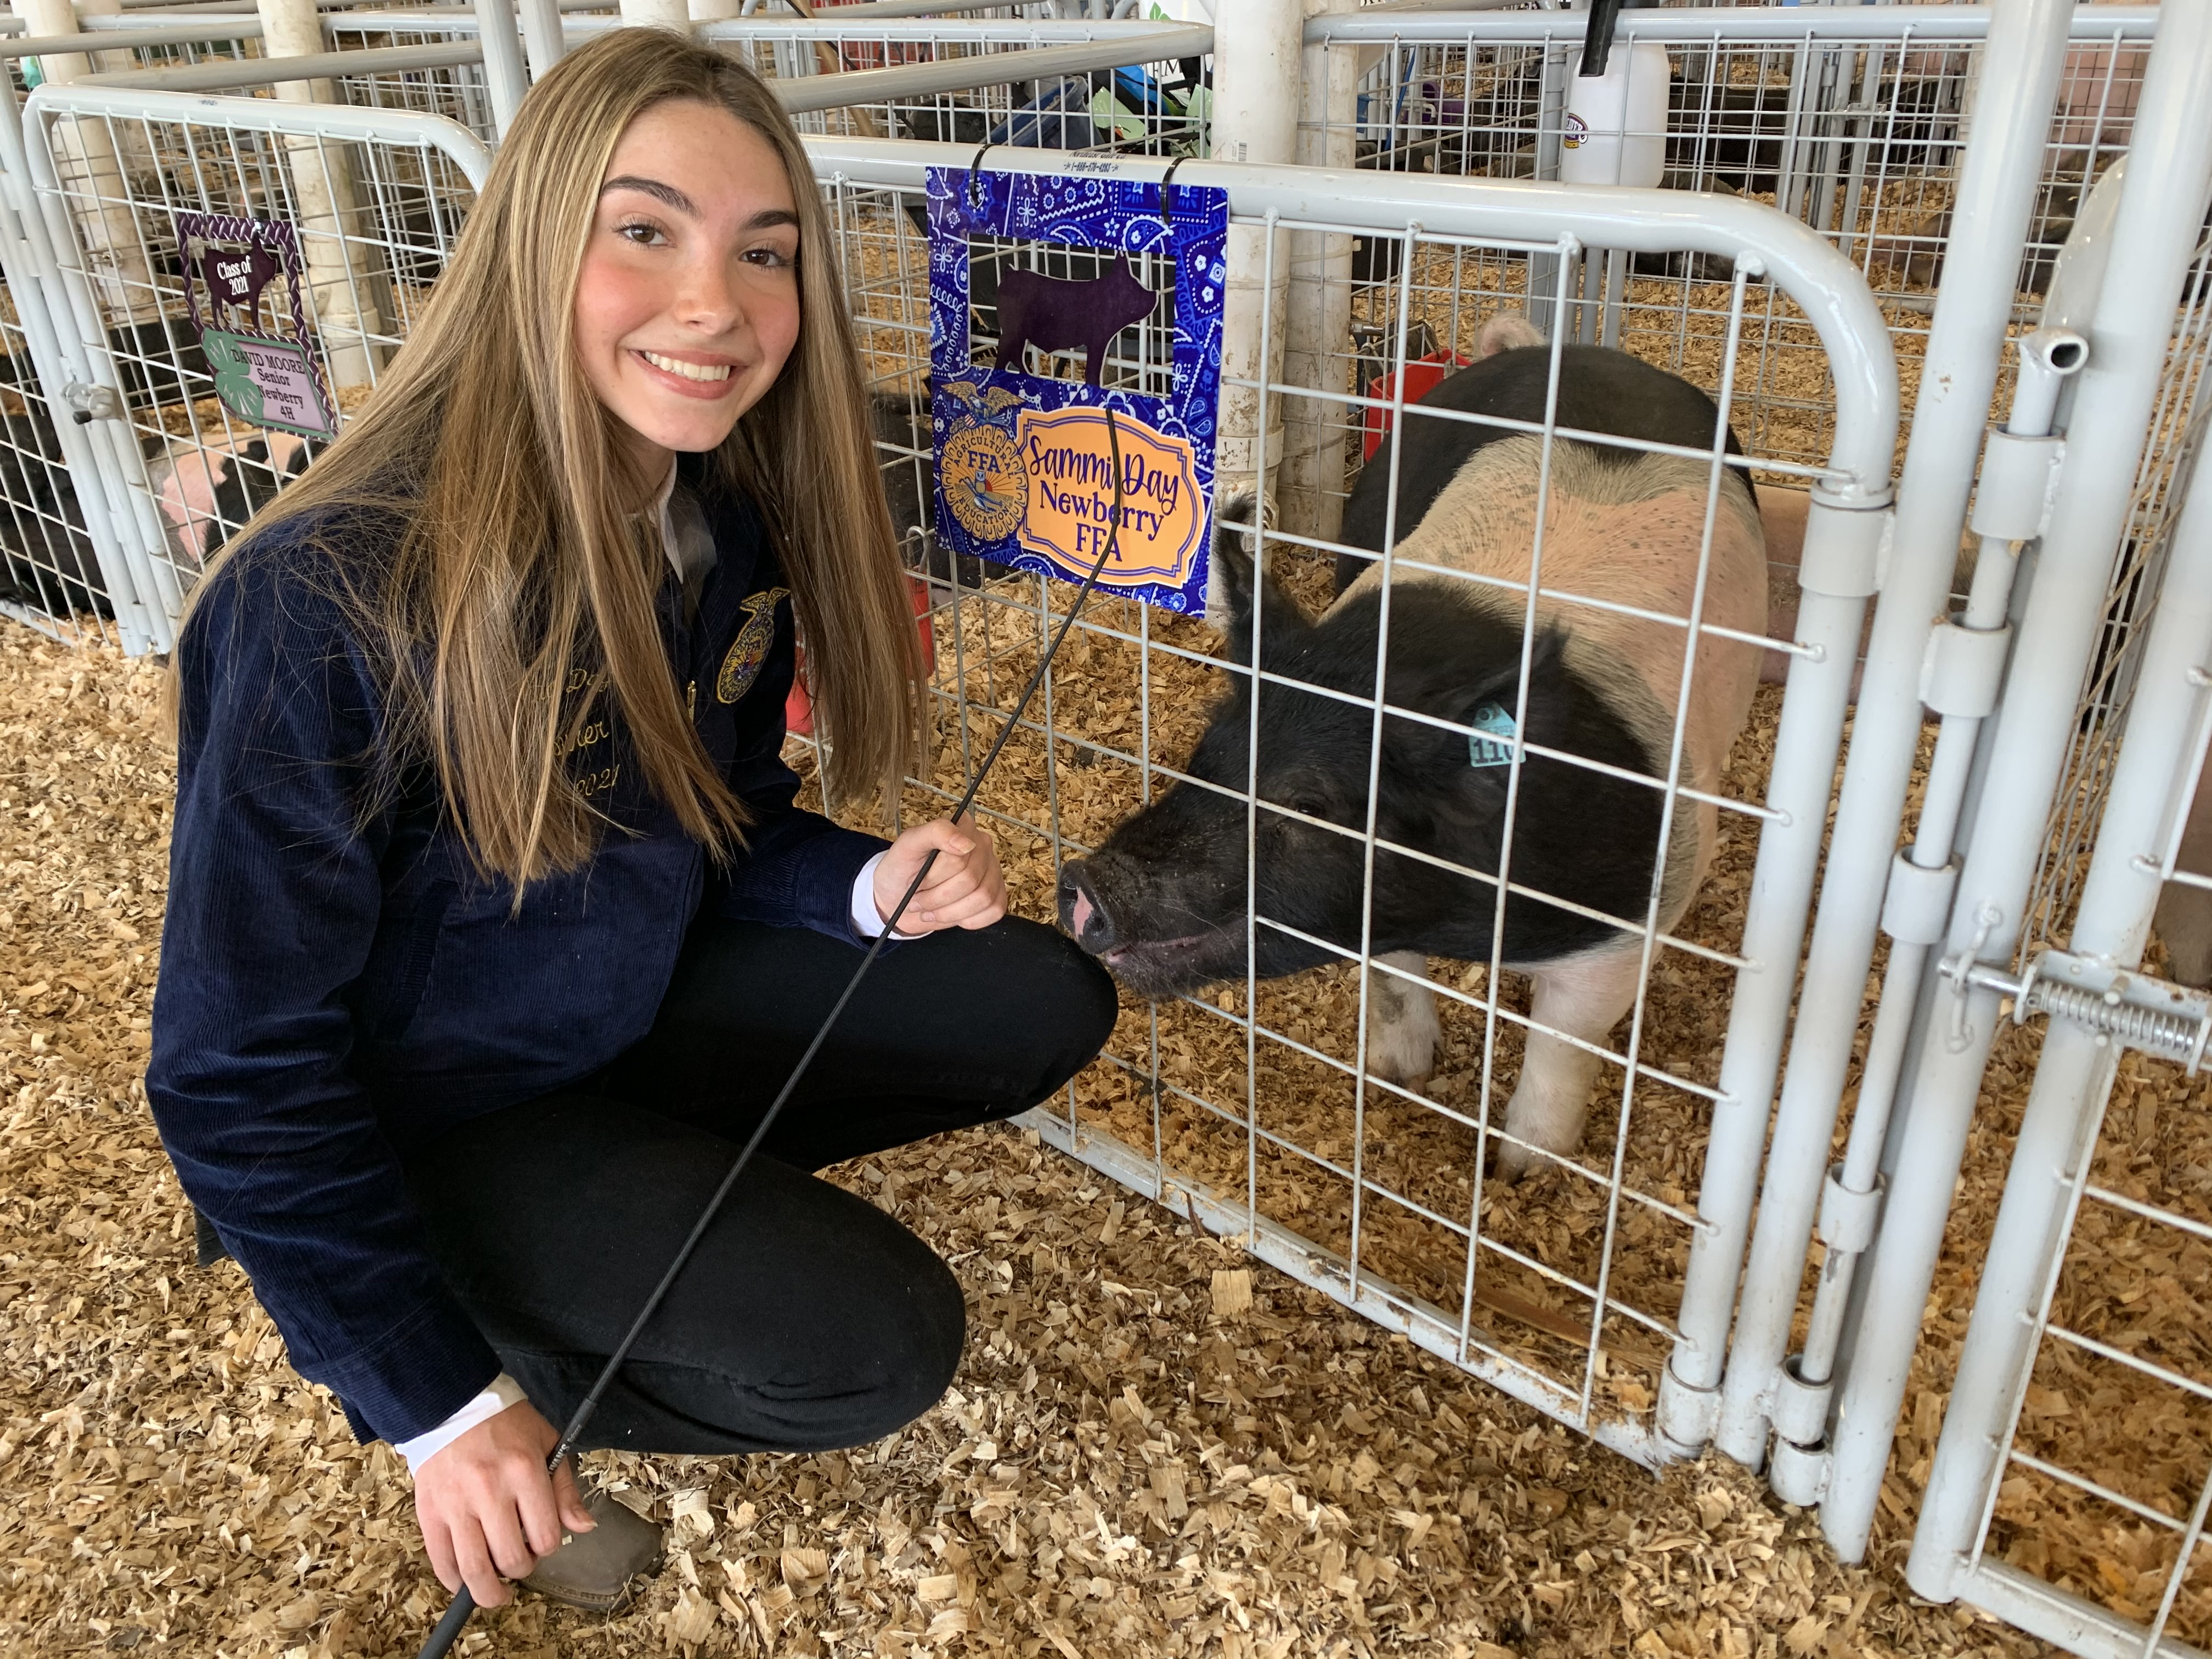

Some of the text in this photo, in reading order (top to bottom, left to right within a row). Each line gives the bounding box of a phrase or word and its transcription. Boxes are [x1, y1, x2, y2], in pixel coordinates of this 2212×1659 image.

[217, 255, 252, 280] Class of
[228, 275, 249, 296] 2021
[230, 349, 264, 366] DAVID
[264, 354, 306, 375] MOORE
[257, 368, 290, 386] Senior
[257, 385, 303, 409] Newberry
[280, 405, 295, 421] 4H
[953, 436, 1014, 479] AGRICULTURAL
[967, 450, 1001, 474] FFA
[1030, 435, 1178, 516] Sammi Day
[958, 495, 1009, 524] EDUCATION
[1040, 480, 1164, 541] Newberry
[1076, 522, 1122, 562] FFA
